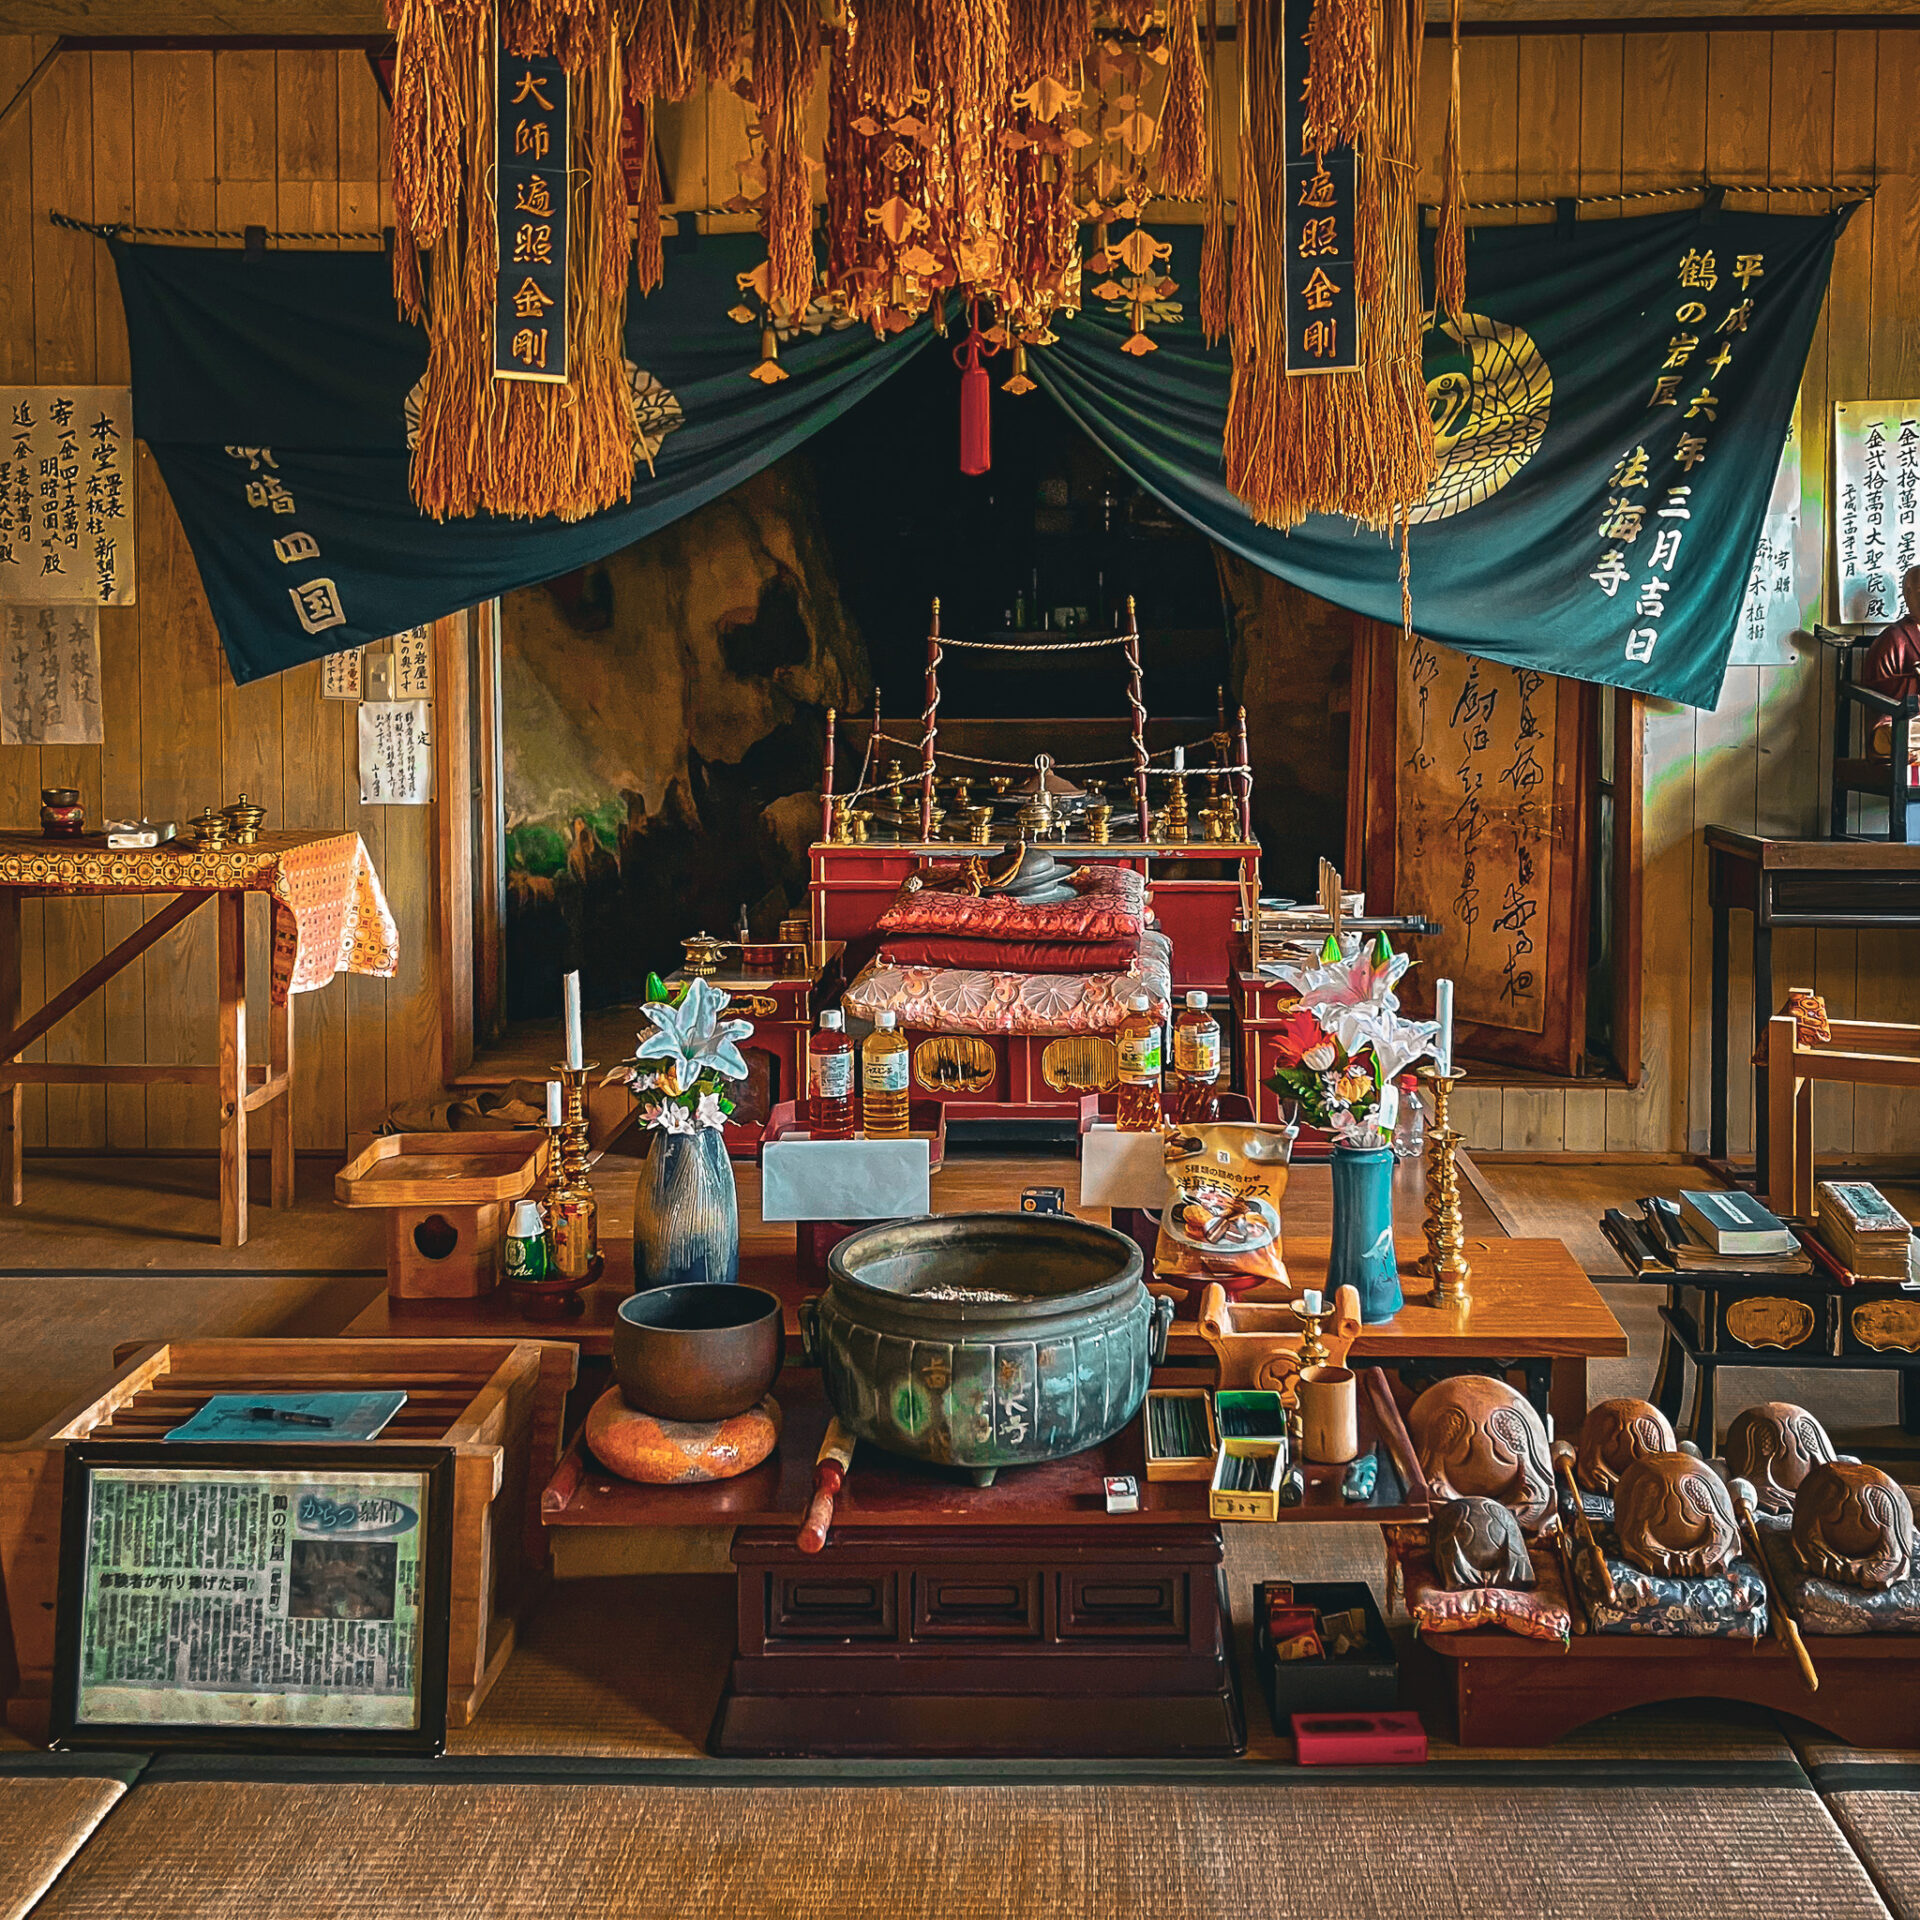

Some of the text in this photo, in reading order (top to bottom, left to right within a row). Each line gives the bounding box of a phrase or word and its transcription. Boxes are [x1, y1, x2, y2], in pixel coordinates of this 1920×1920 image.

[511, 48, 557, 369] 大師遍照金剛
[1589, 248, 1719, 597] 鶴の岩屋 法海寺
[1624, 253, 1764, 664] 平成十六年三月吉日
[1176, 1175, 1271, 1199] 洋菓子ミックス
[1184, 1164, 1262, 1183] 5種類の詰め合わせ
